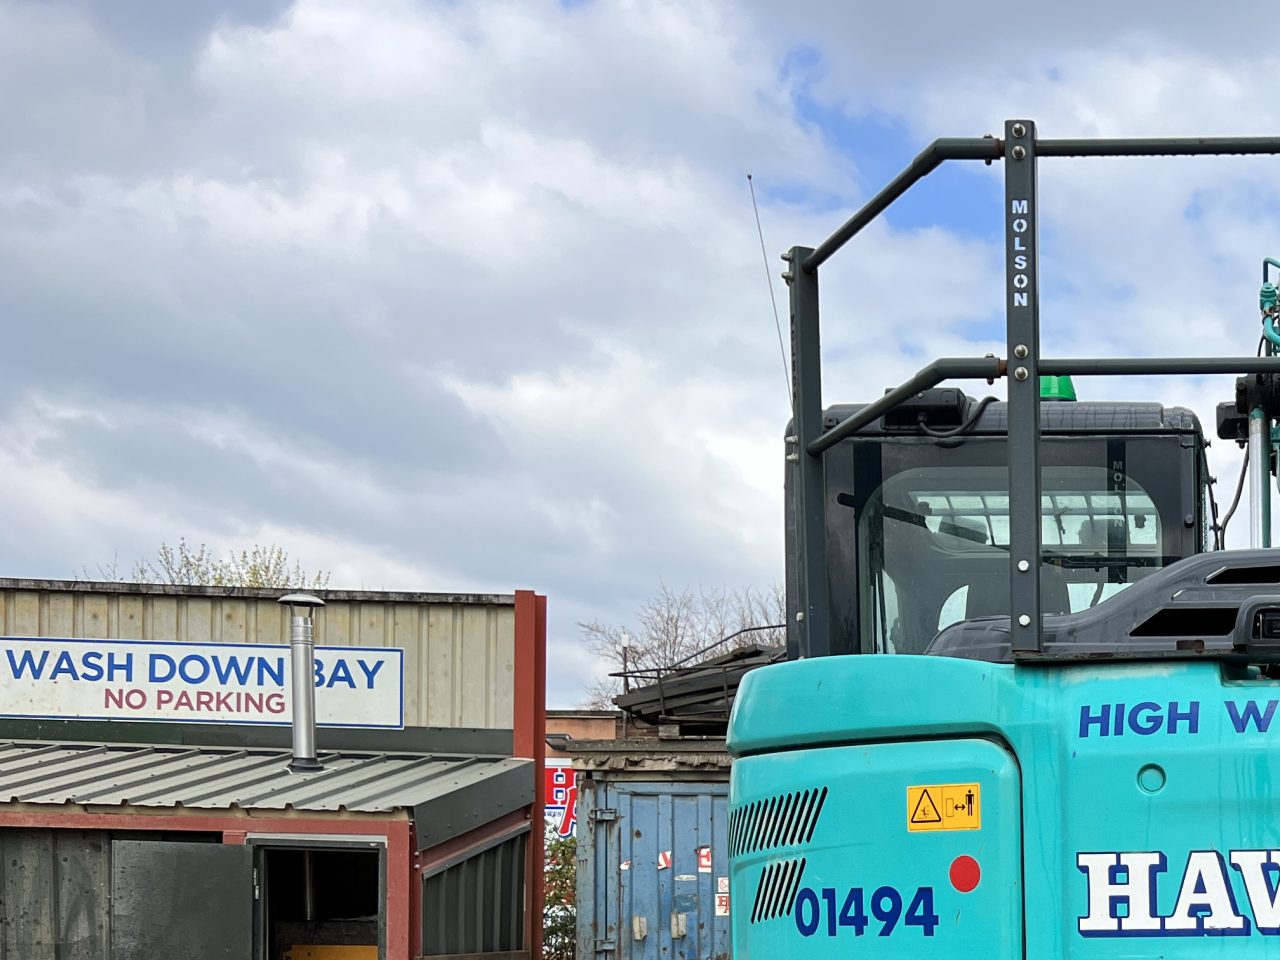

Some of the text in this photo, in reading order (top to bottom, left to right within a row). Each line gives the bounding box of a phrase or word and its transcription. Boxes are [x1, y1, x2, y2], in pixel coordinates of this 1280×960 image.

[1012, 200, 1028, 306] MOLSON
[6, 650, 133, 682] WASH
[149, 653, 284, 686] DOWN
[104, 688, 285, 714] NO PARKING
[1079, 701, 1200, 738] HIGH
[795, 886, 939, 937] 01494
